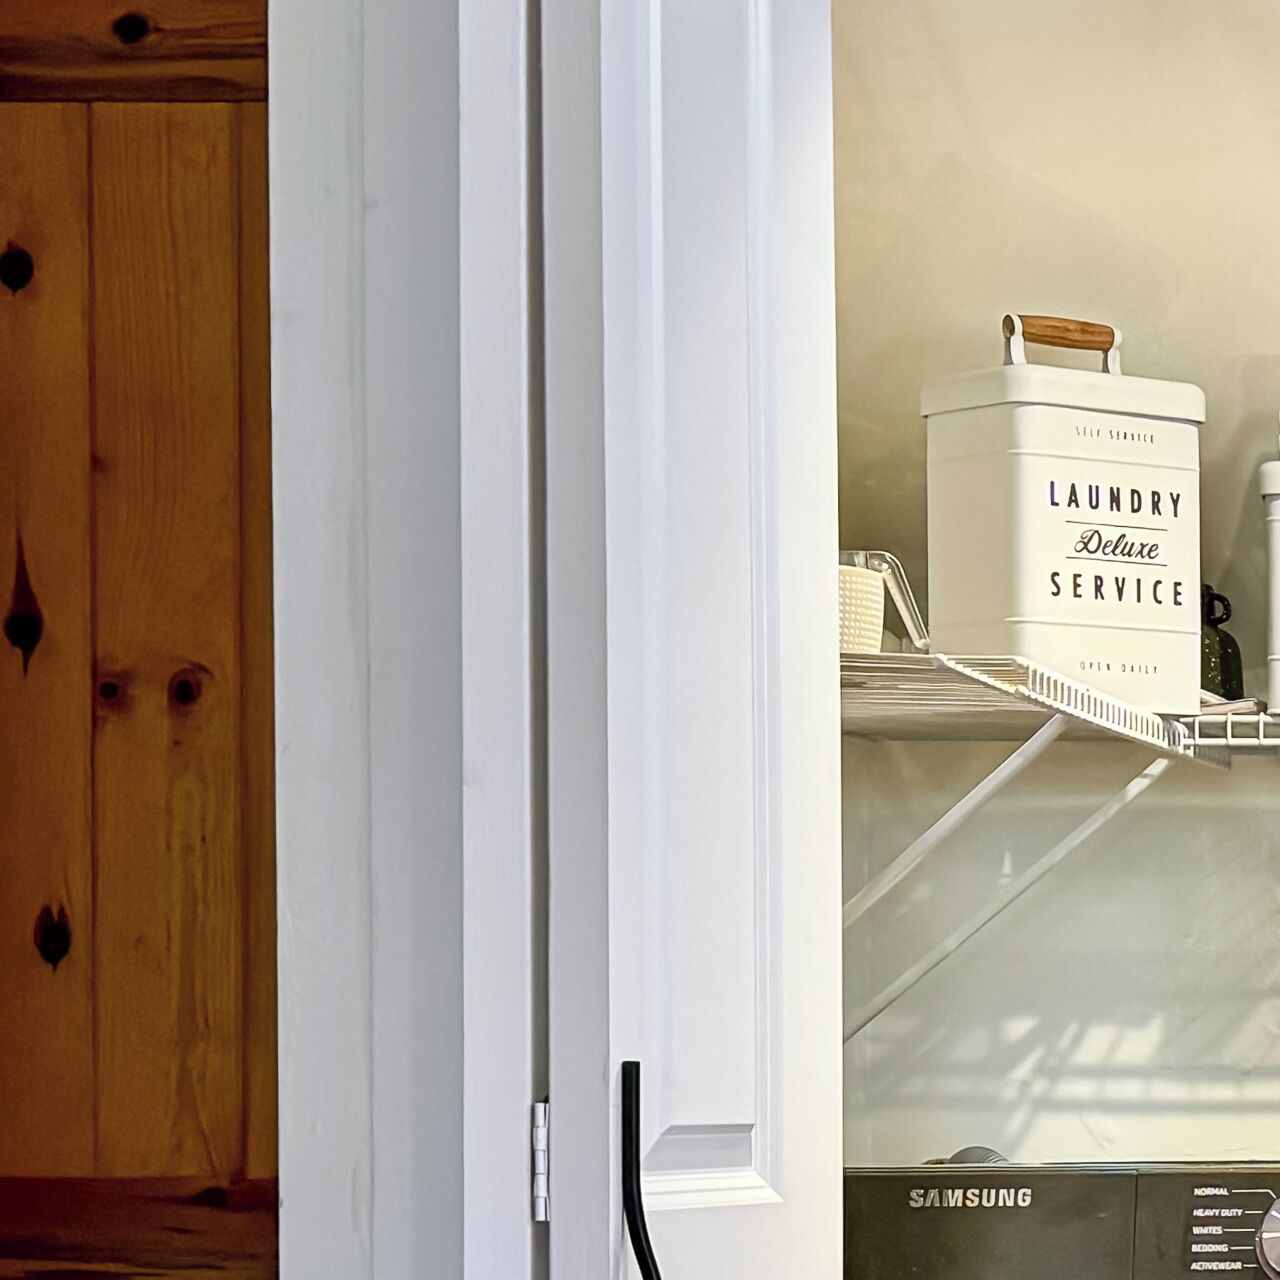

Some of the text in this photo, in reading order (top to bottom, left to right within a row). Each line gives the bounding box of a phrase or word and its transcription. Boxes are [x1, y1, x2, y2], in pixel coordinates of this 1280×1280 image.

[1076, 426, 1154, 444] SELF SERVICE
[1050, 480, 1181, 518] LAUNDRY
[1074, 529, 1159, 560] Deluxe
[1050, 572, 1183, 606] SERVICE
[1121, 664, 1157, 674] DAILY
[1193, 1187, 1229, 1196] NORMAL
[909, 1188, 1032, 1208] SAMSUNG
[1192, 1209, 1243, 1217] HEAVY DUTY
[1192, 1226, 1223, 1234] WHITES
[1191, 1244, 1229, 1252] BEDDING
[1190, 1262, 1242, 1270] ACTIVEWEAR
